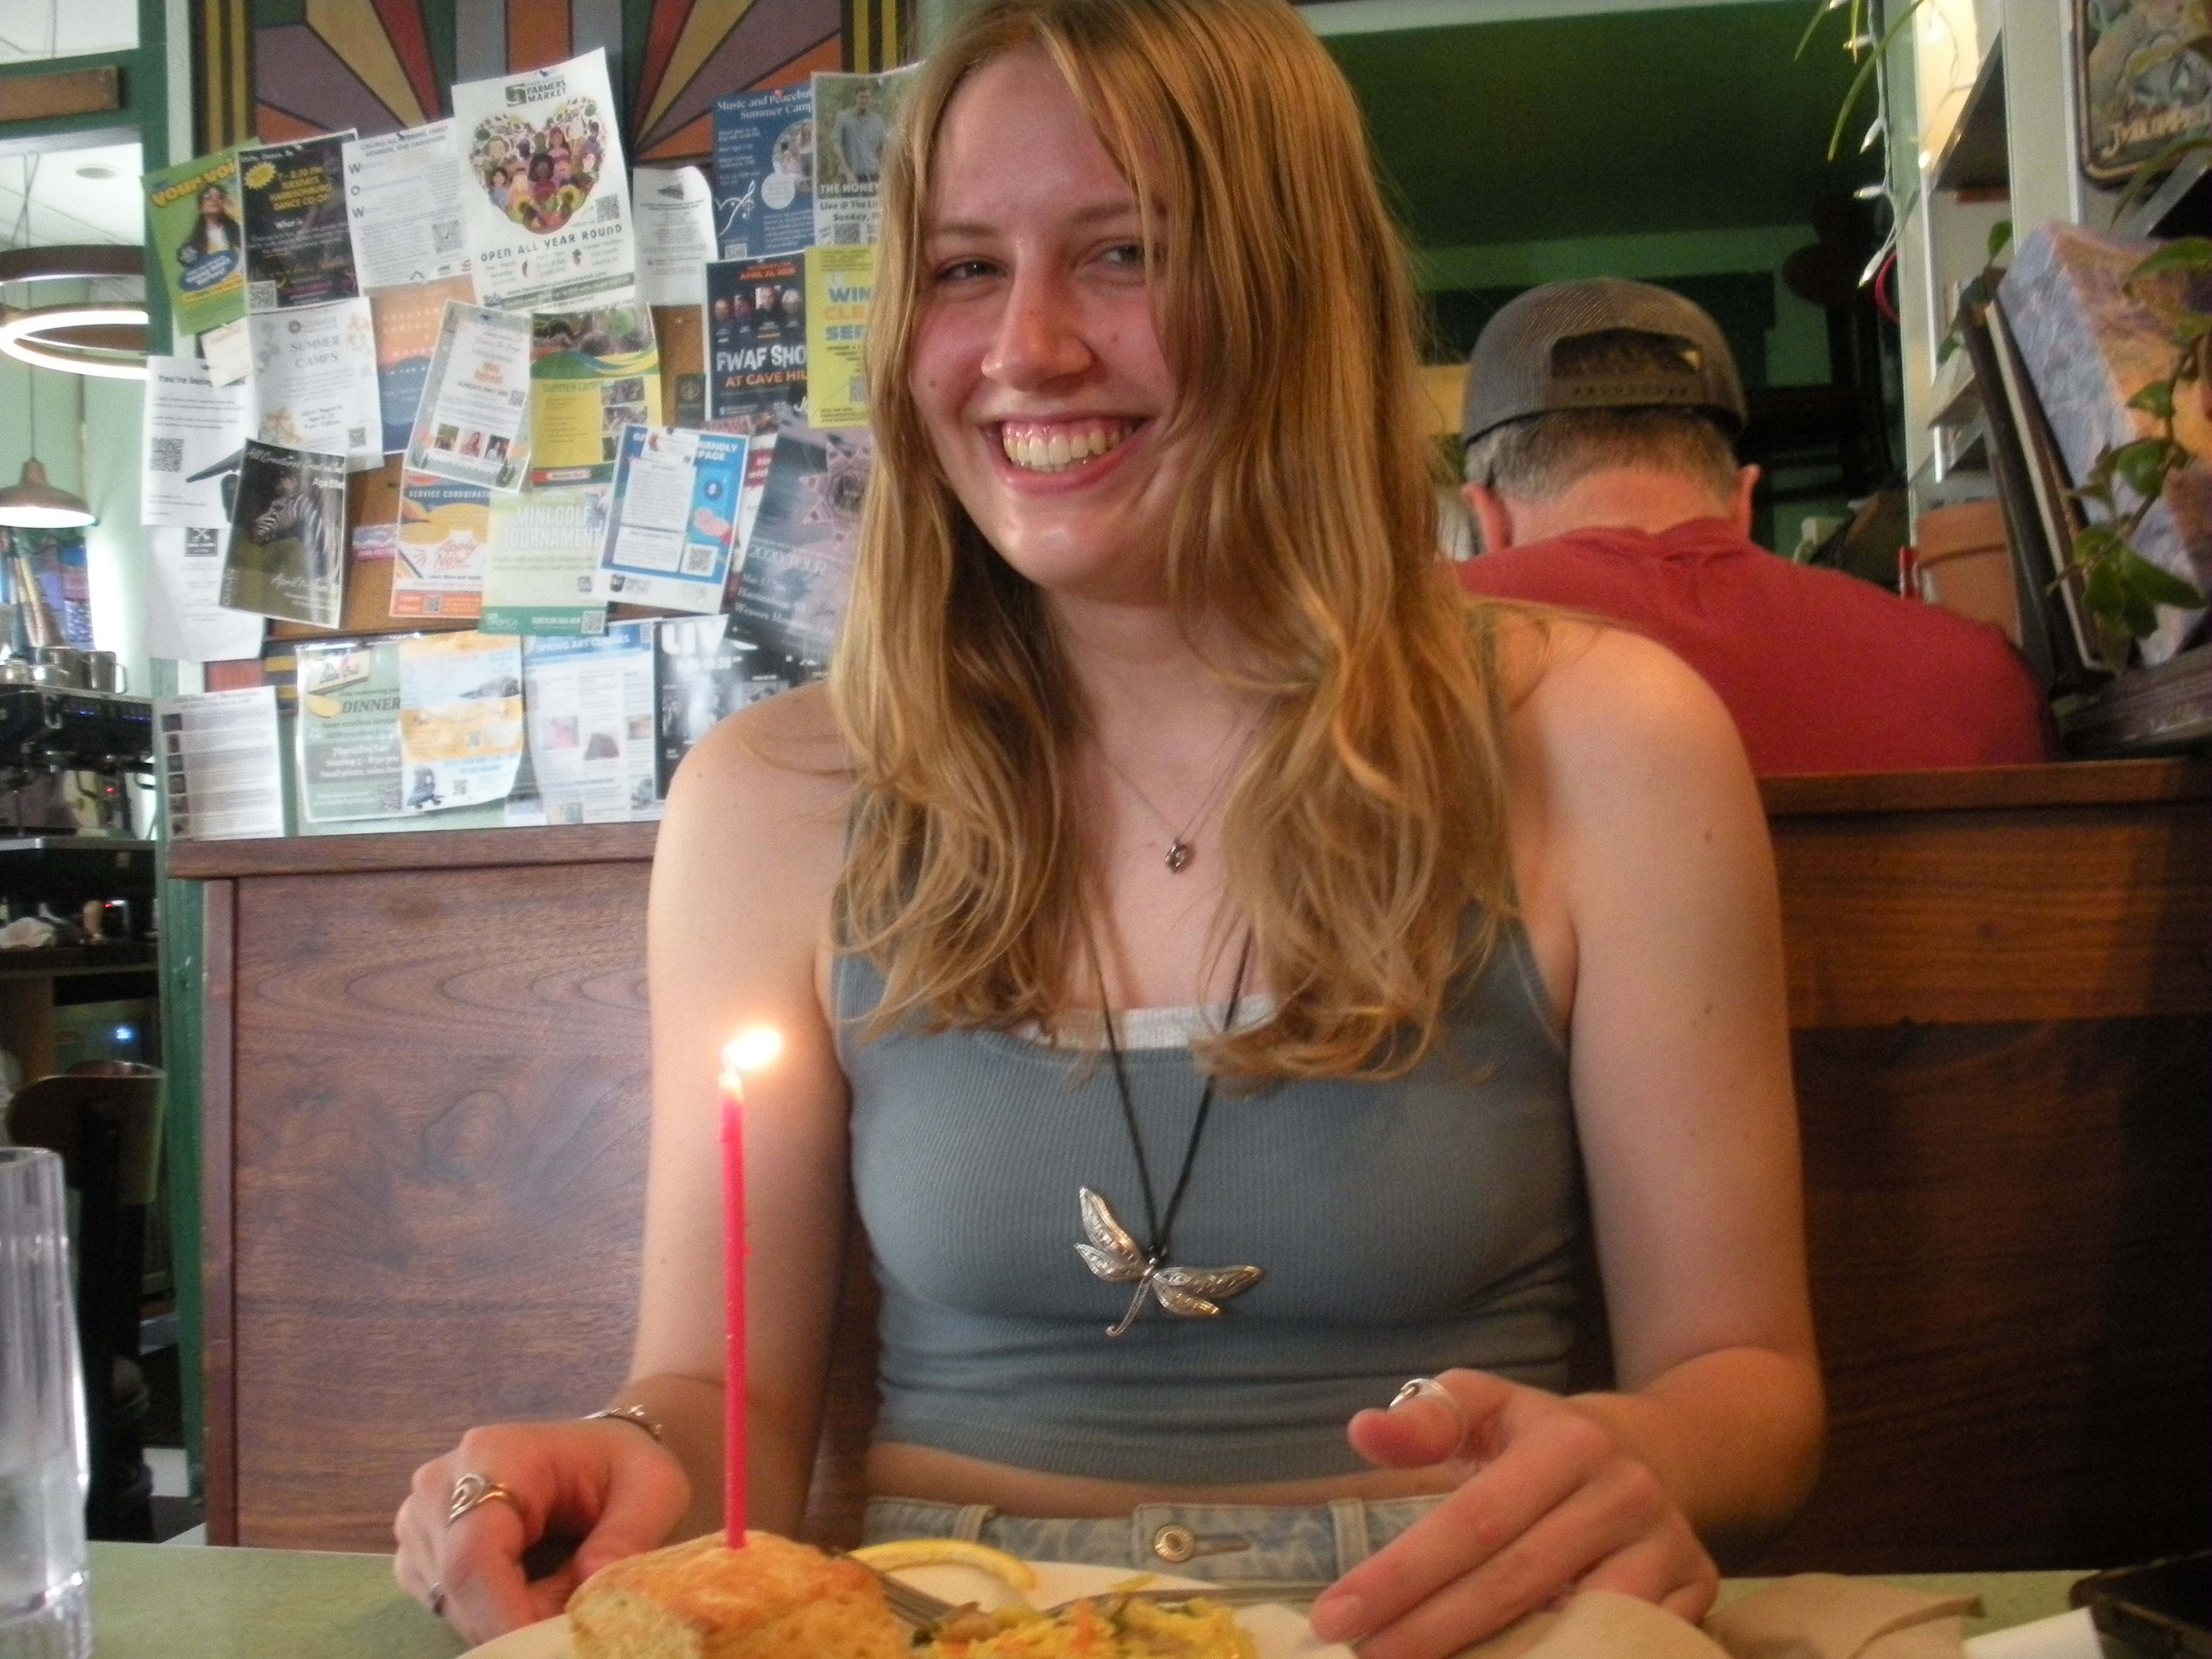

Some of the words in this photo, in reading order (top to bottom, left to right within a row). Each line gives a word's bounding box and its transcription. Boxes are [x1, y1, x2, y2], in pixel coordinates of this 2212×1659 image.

[527, 79, 566, 95] FARMERS
[528, 87, 566, 102] MARKET
[717, 99, 746, 110] Music
[748, 98, 767, 107] and
[740, 106, 782, 119] Summer
[348, 163, 361, 174] W
[350, 185, 360, 196] O
[820, 185, 840, 193] THE
[352, 206, 364, 218] W
[480, 248, 511, 262] OPEN
[517, 243, 538, 255] ALL
[544, 233, 576, 249] YEAR
[582, 224, 623, 240] ROUND
[295, 353, 339, 368] CAMPS
[716, 346, 767, 372] FWAF
[725, 375, 742, 387] AT
[745, 372, 783, 386] CAVE
[409, 489, 440, 498] SERVICE
[341, 698, 401, 714] DINNER
